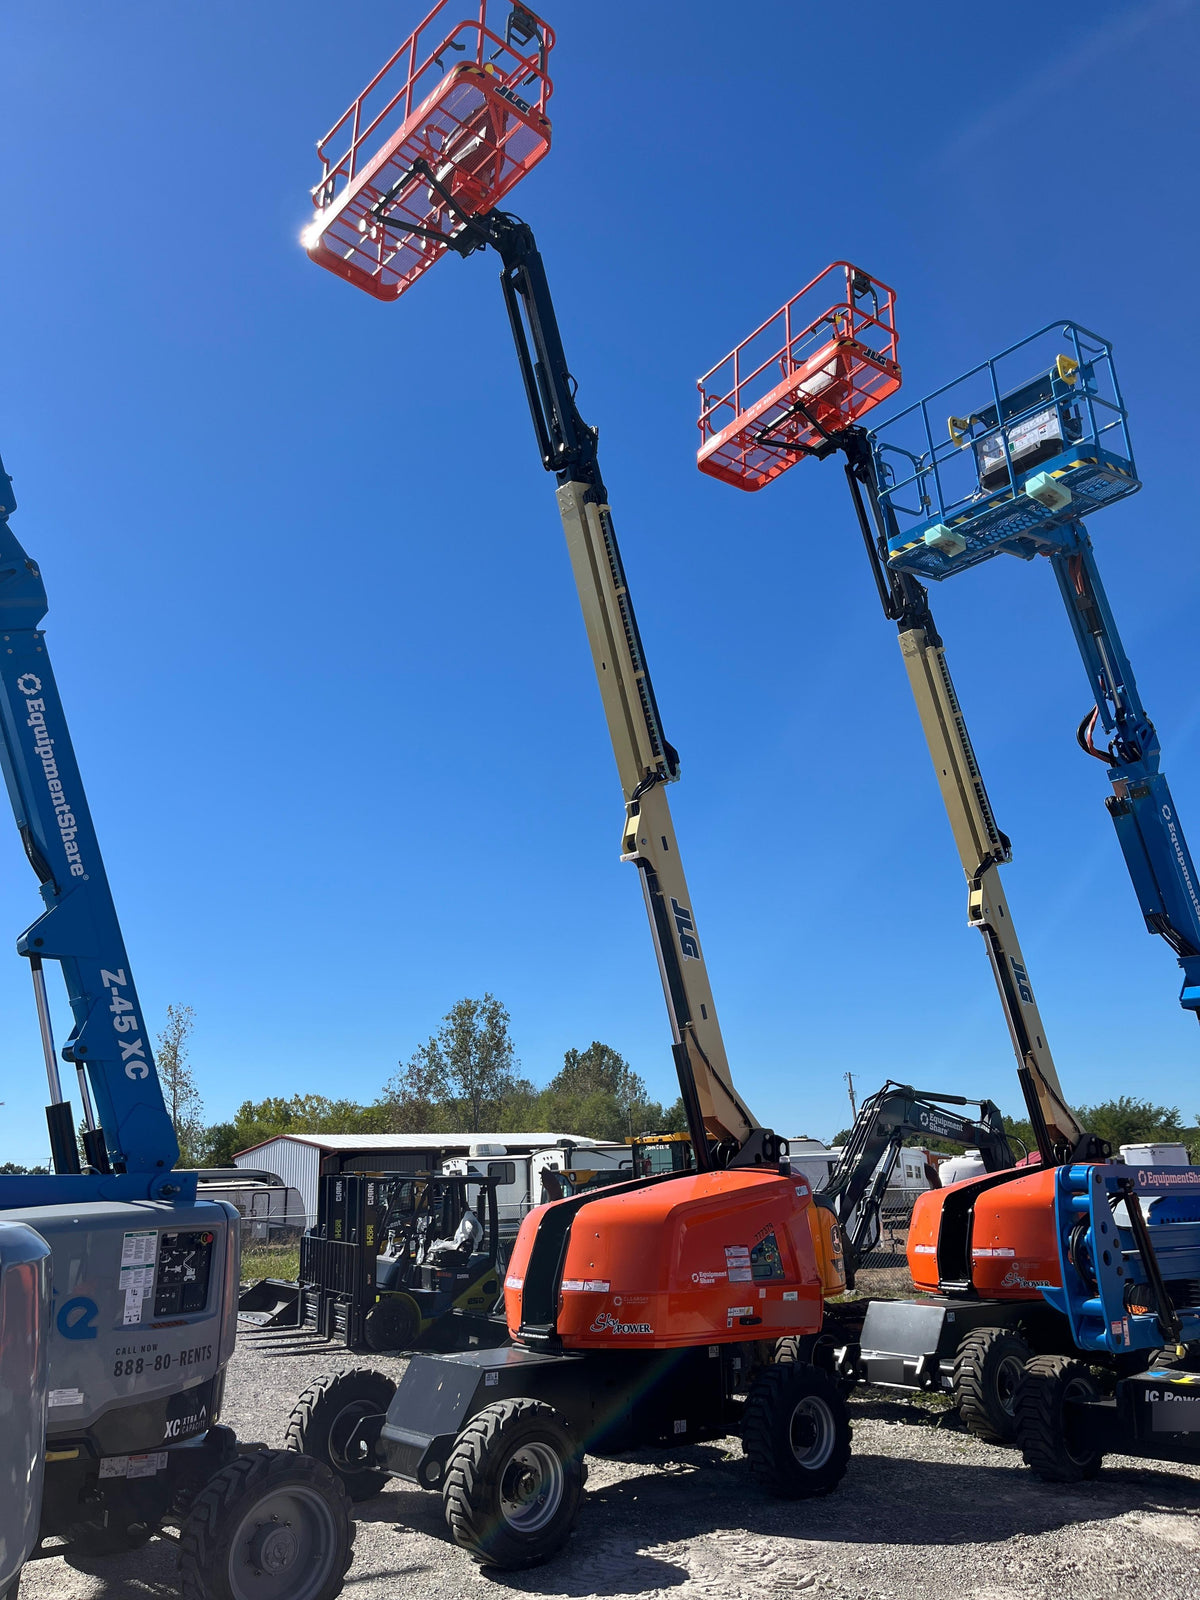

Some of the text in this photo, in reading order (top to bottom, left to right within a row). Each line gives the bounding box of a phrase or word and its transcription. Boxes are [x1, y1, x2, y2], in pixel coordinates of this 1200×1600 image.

[493, 84, 531, 116] JLG
[862, 347, 887, 367] JLG
[670, 896, 701, 961] JLG
[1009, 955, 1035, 1005] JLG
[100, 969, 149, 1080] Z-45 XC
[929, 1112, 963, 1132] Equipment
[113, 1345, 212, 1377] 888-80-RENTS
[115, 1344, 159, 1356] CALL NOW
[1145, 1390, 1159, 1402] IC
[163, 1415, 198, 1439] XC XTRA
